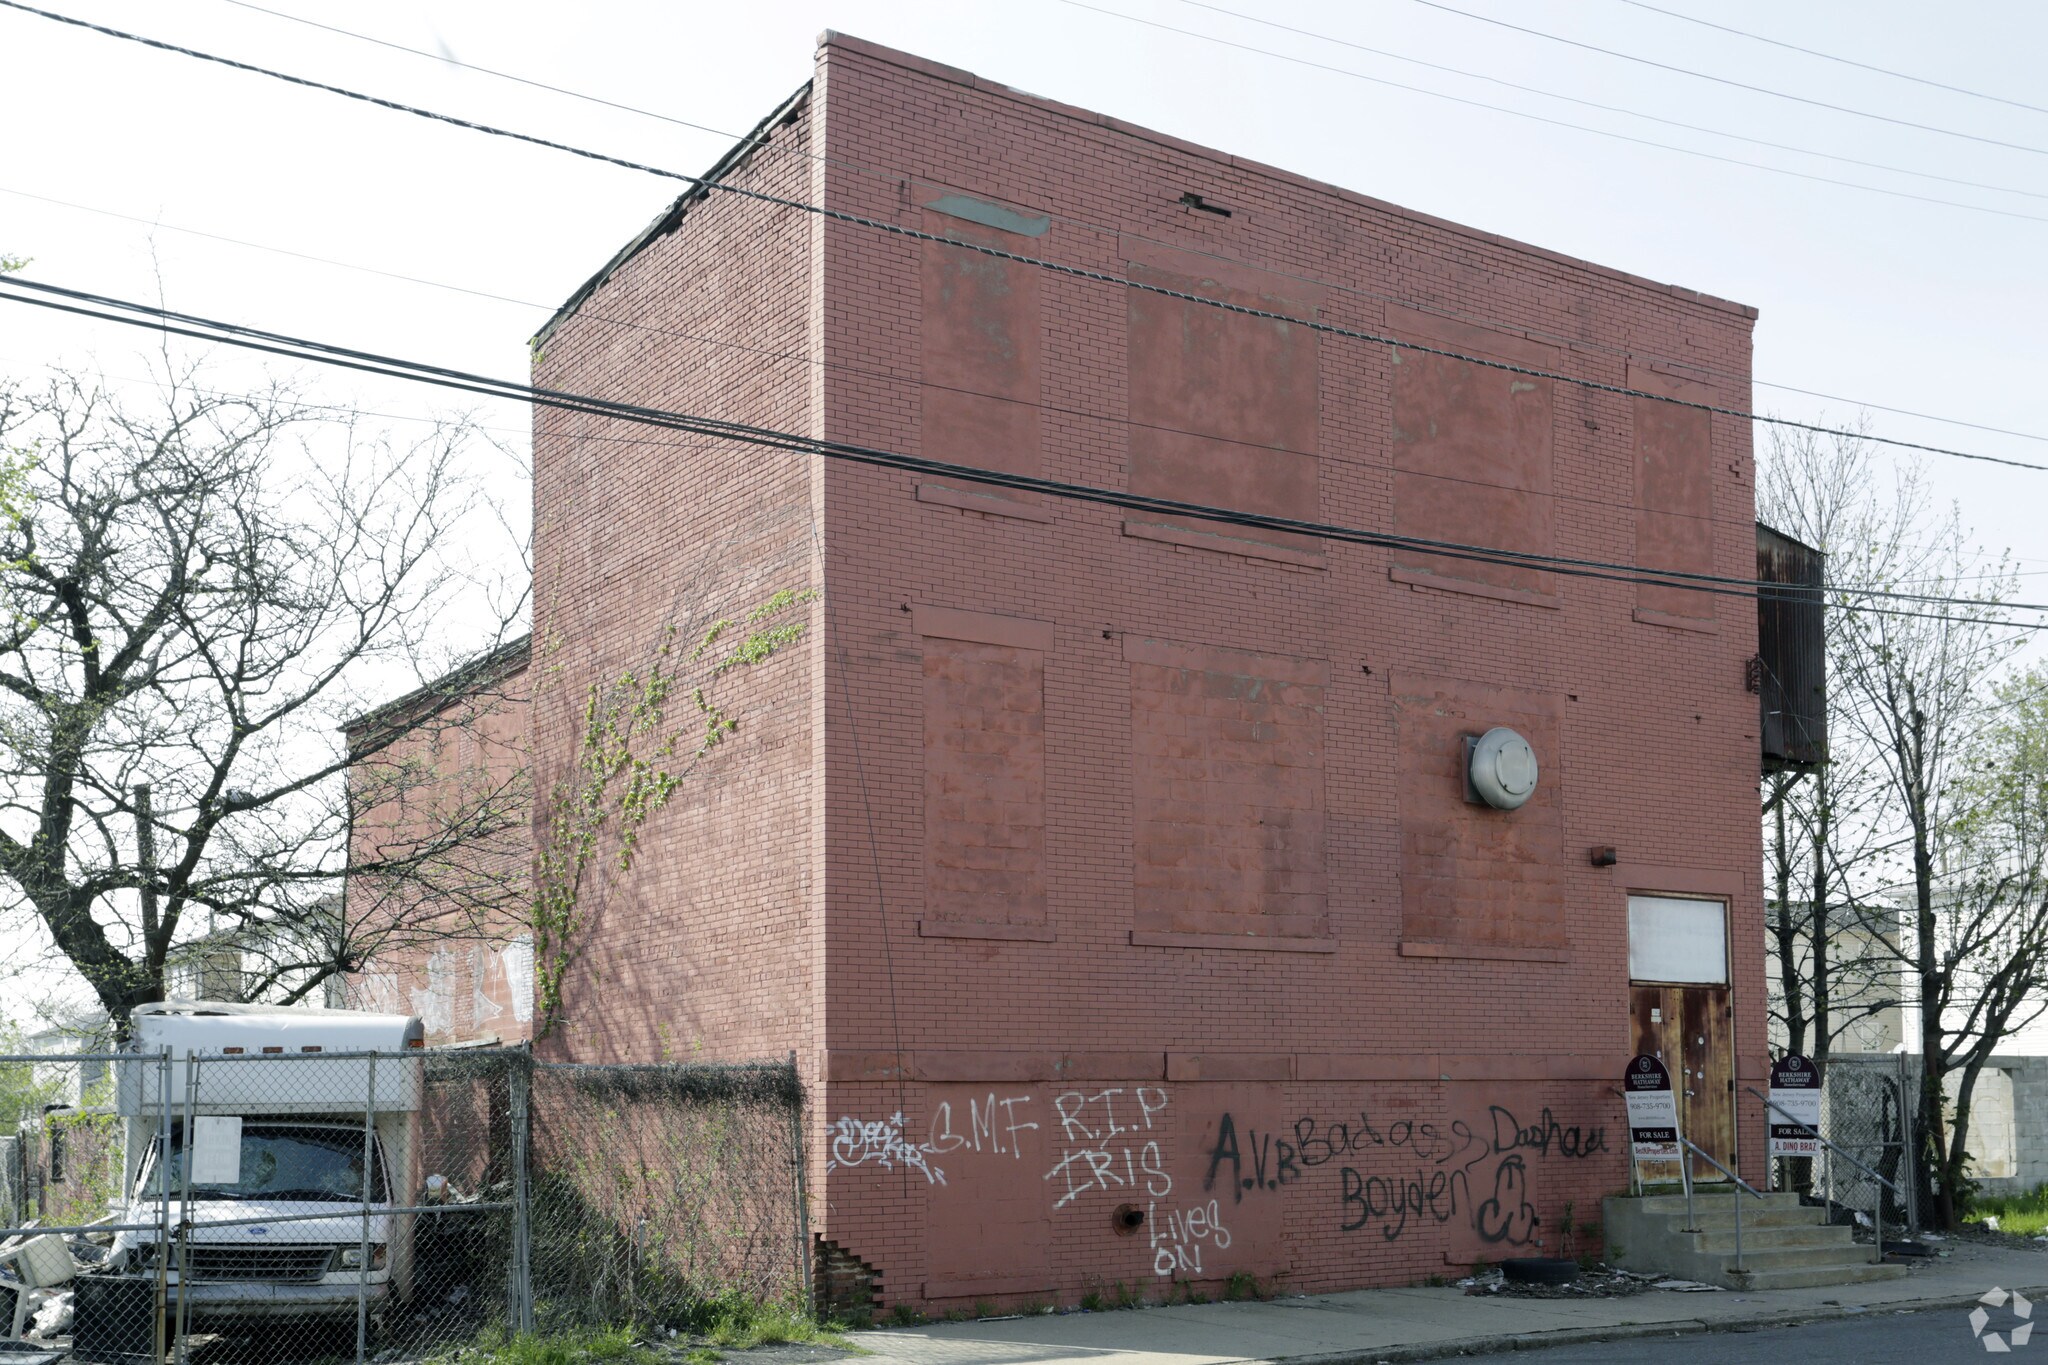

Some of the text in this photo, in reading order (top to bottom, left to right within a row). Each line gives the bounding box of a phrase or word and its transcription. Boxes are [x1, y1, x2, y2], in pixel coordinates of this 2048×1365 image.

[1775, 1142, 1816, 1151] A. DINO BRAZ
[1043, 1141, 1172, 1210] IRIS
[1340, 1167, 1476, 1241] Boyden
[1154, 1243, 1202, 1276] ON
